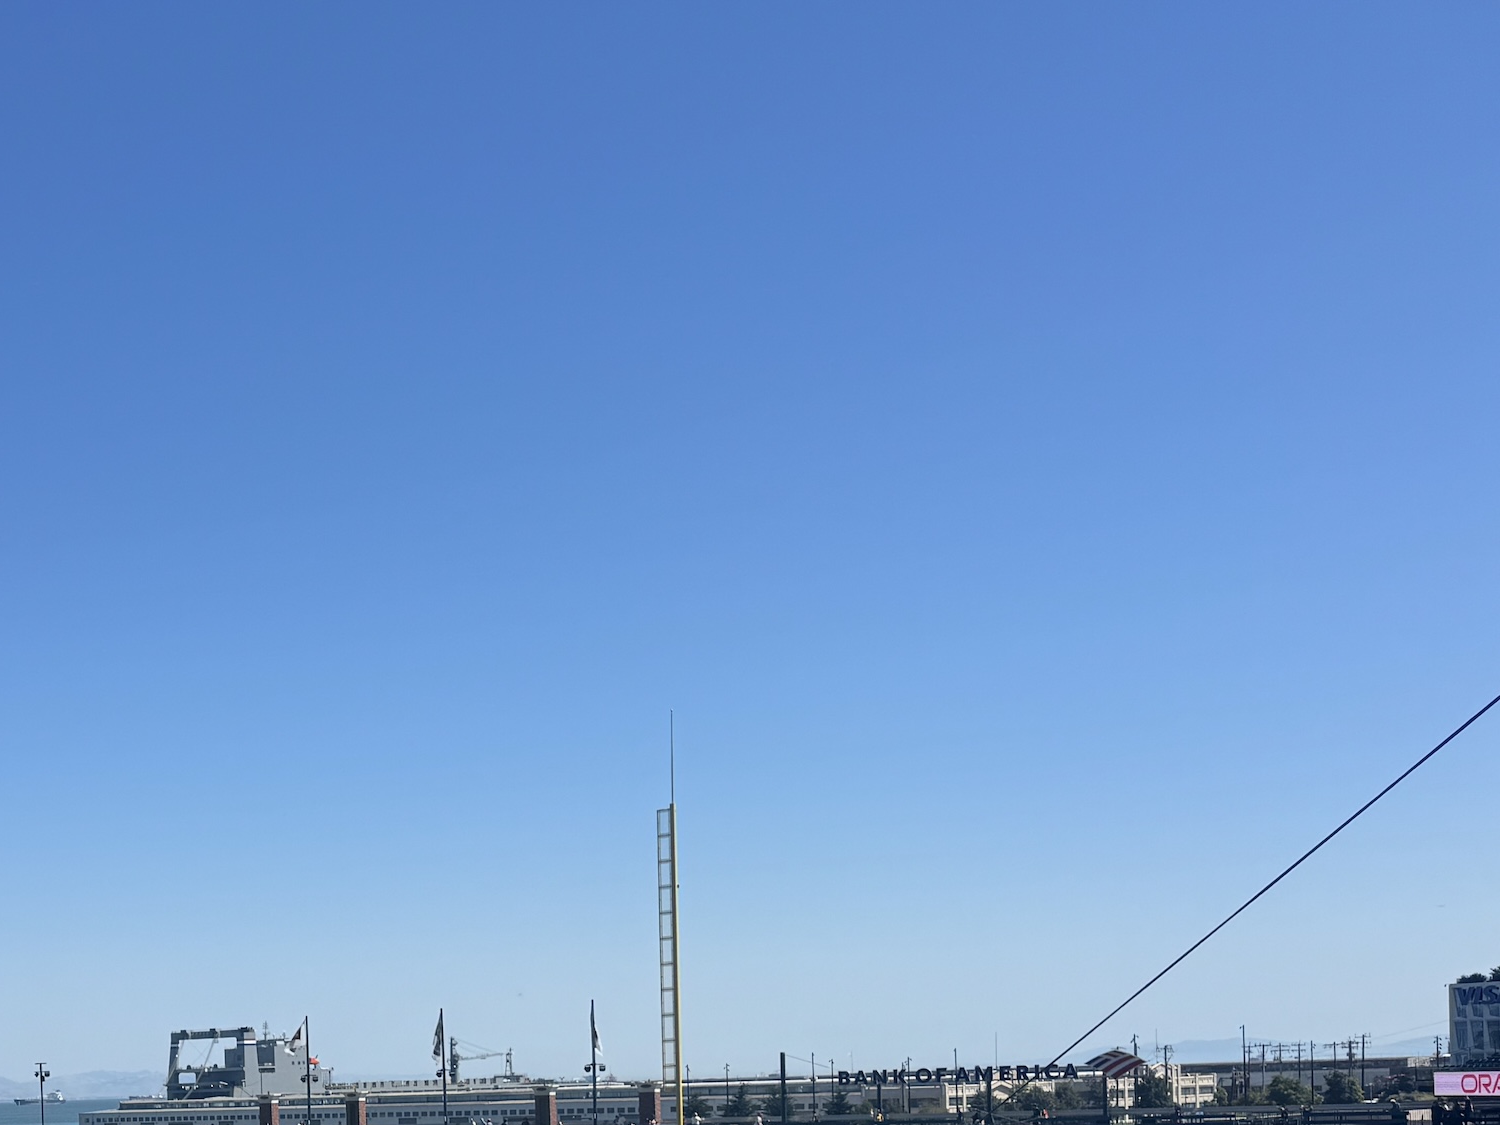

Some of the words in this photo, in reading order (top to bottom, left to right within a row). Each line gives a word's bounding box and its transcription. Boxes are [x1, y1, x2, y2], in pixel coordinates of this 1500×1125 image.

[1454, 985, 1500, 1005] VIS
[838, 1069, 906, 1086] BANK
[916, 1068, 947, 1084] OF
[957, 1063, 1079, 1083] AMERICA
